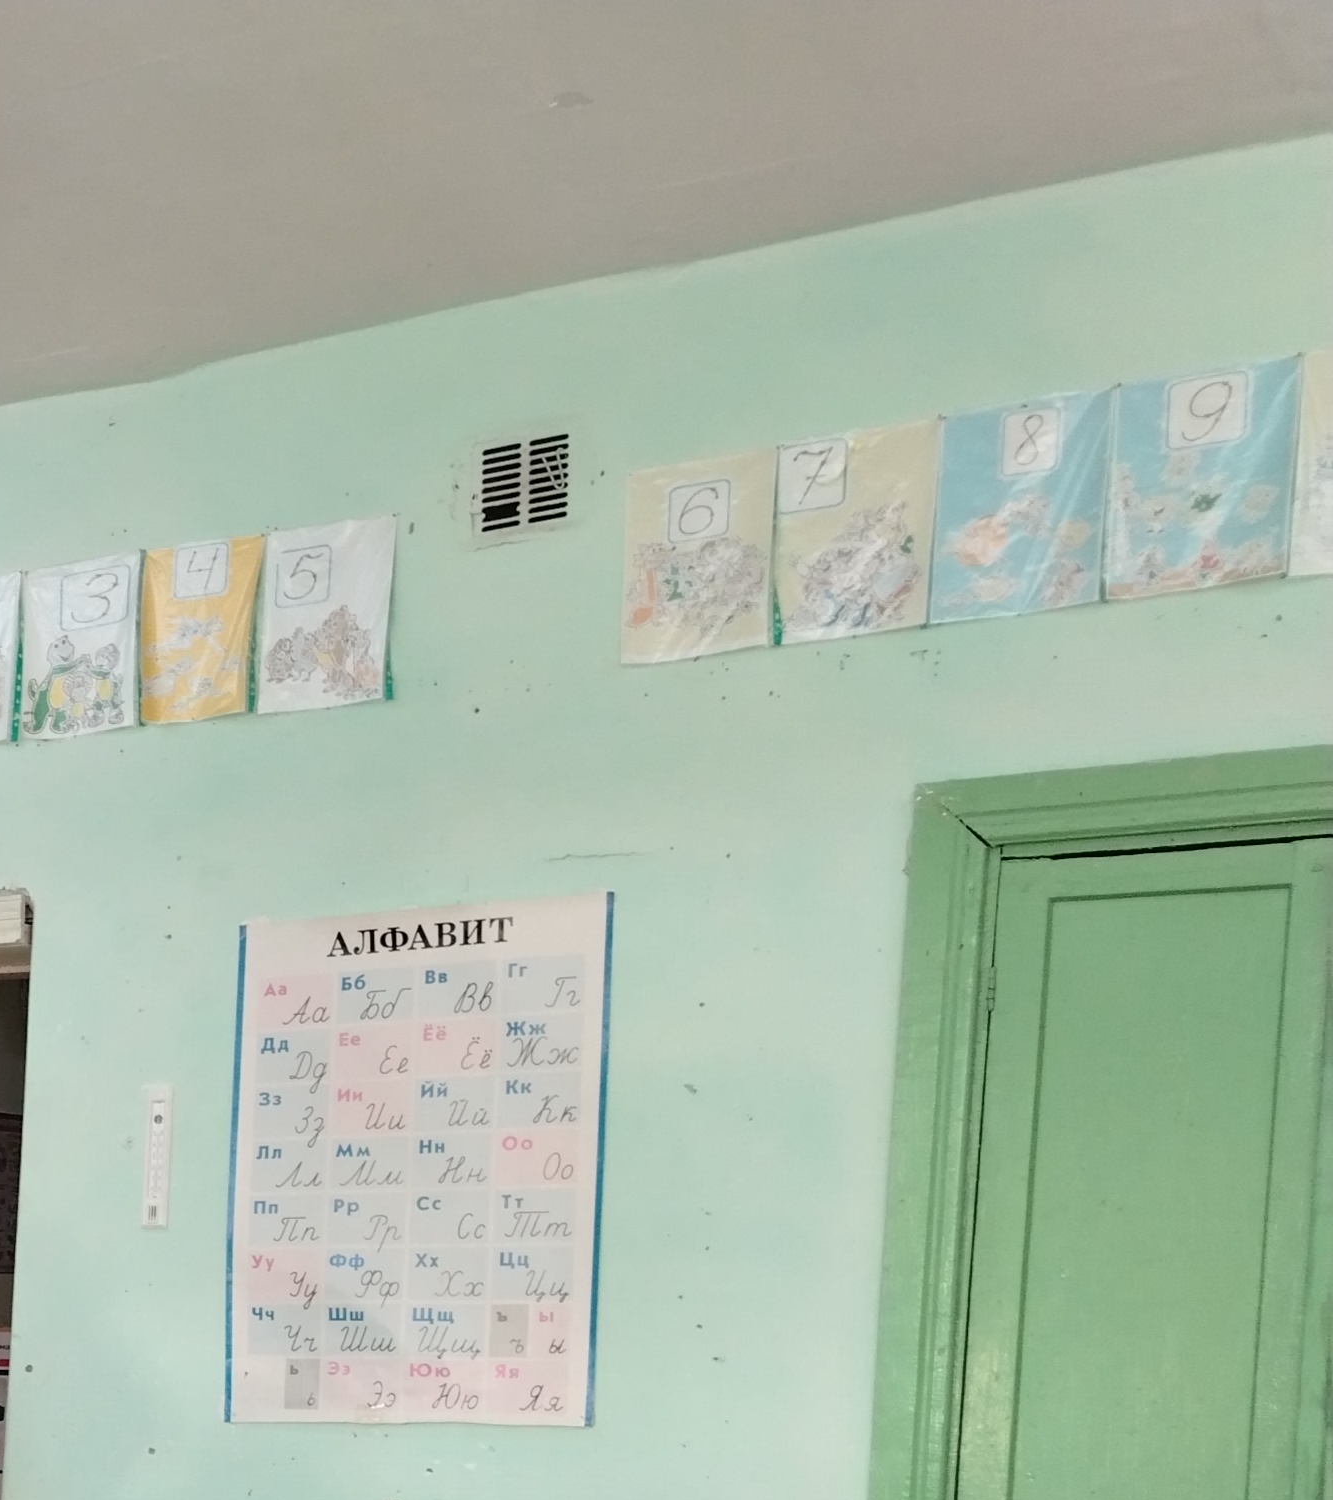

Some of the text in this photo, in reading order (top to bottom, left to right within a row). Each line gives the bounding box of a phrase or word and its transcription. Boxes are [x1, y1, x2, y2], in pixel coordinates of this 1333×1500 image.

[679, 381, 1233, 535] 6 7 8 9
[71, 573, 119, 623] 3
[189, 547, 216, 590] 4
[284, 552, 324, 598] 5
[327, 916, 513, 957] АЛФАВИТ
[264, 963, 527, 997] Аа Бб Вв Гг
[261, 1021, 546, 1054] Дд Ее Ёё Жж
[259, 1080, 532, 1106] Зз Ии Йй Кк
[257, 1136, 533, 1159] Лл Мм Нн Оо
[253, 1195, 523, 1215] Пп Рр Сс Тт
[252, 1253, 530, 1272] Уу Фф Хх Цц
[252, 1308, 554, 1323] Чч Шш Щщ ъ ы
[290, 1362, 519, 1379] ь Ээ Юю Яя
